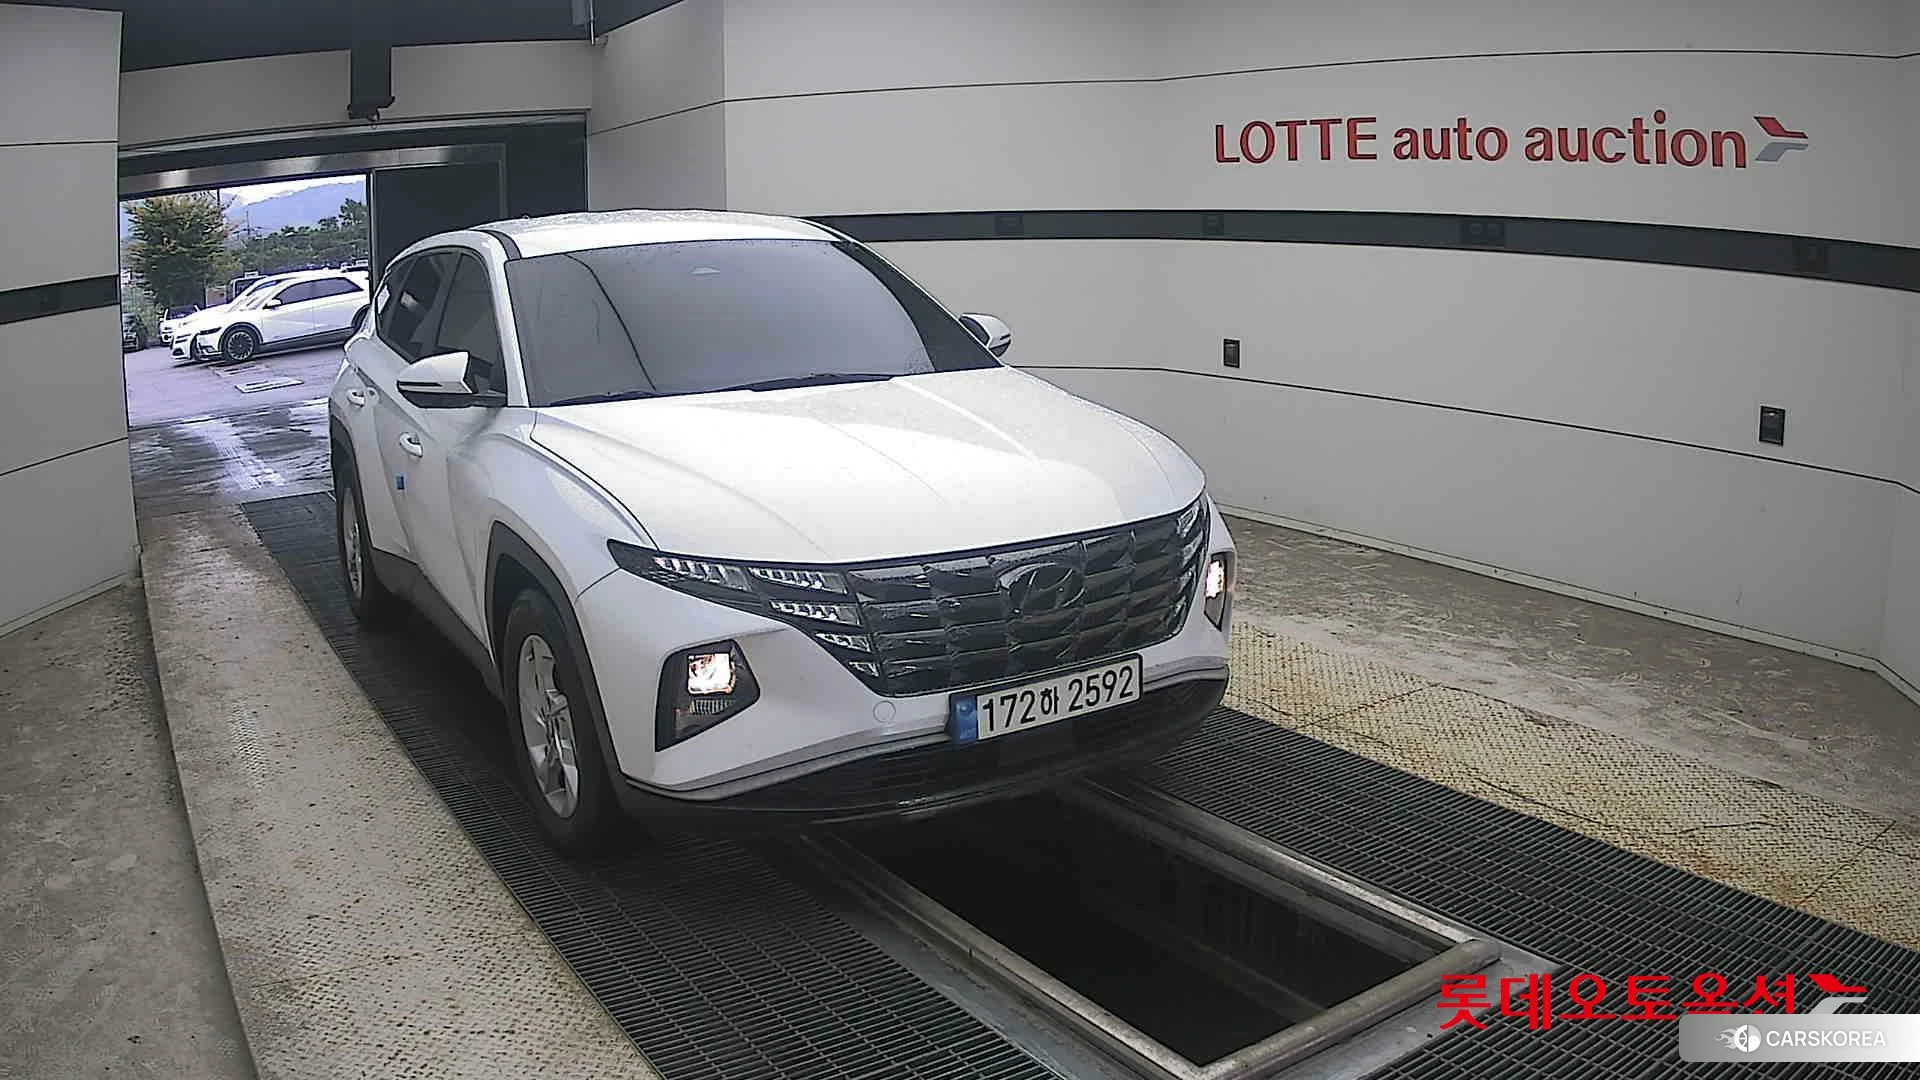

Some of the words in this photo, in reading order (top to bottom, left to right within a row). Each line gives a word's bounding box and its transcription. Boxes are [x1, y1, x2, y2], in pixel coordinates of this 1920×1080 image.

[1214, 116, 1378, 164] LOTTE
[1392, 117, 1509, 163] auto
[1523, 110, 1748, 168] auction
[982, 685, 1060, 732] 172하
[1068, 665, 1134, 713] 2592
